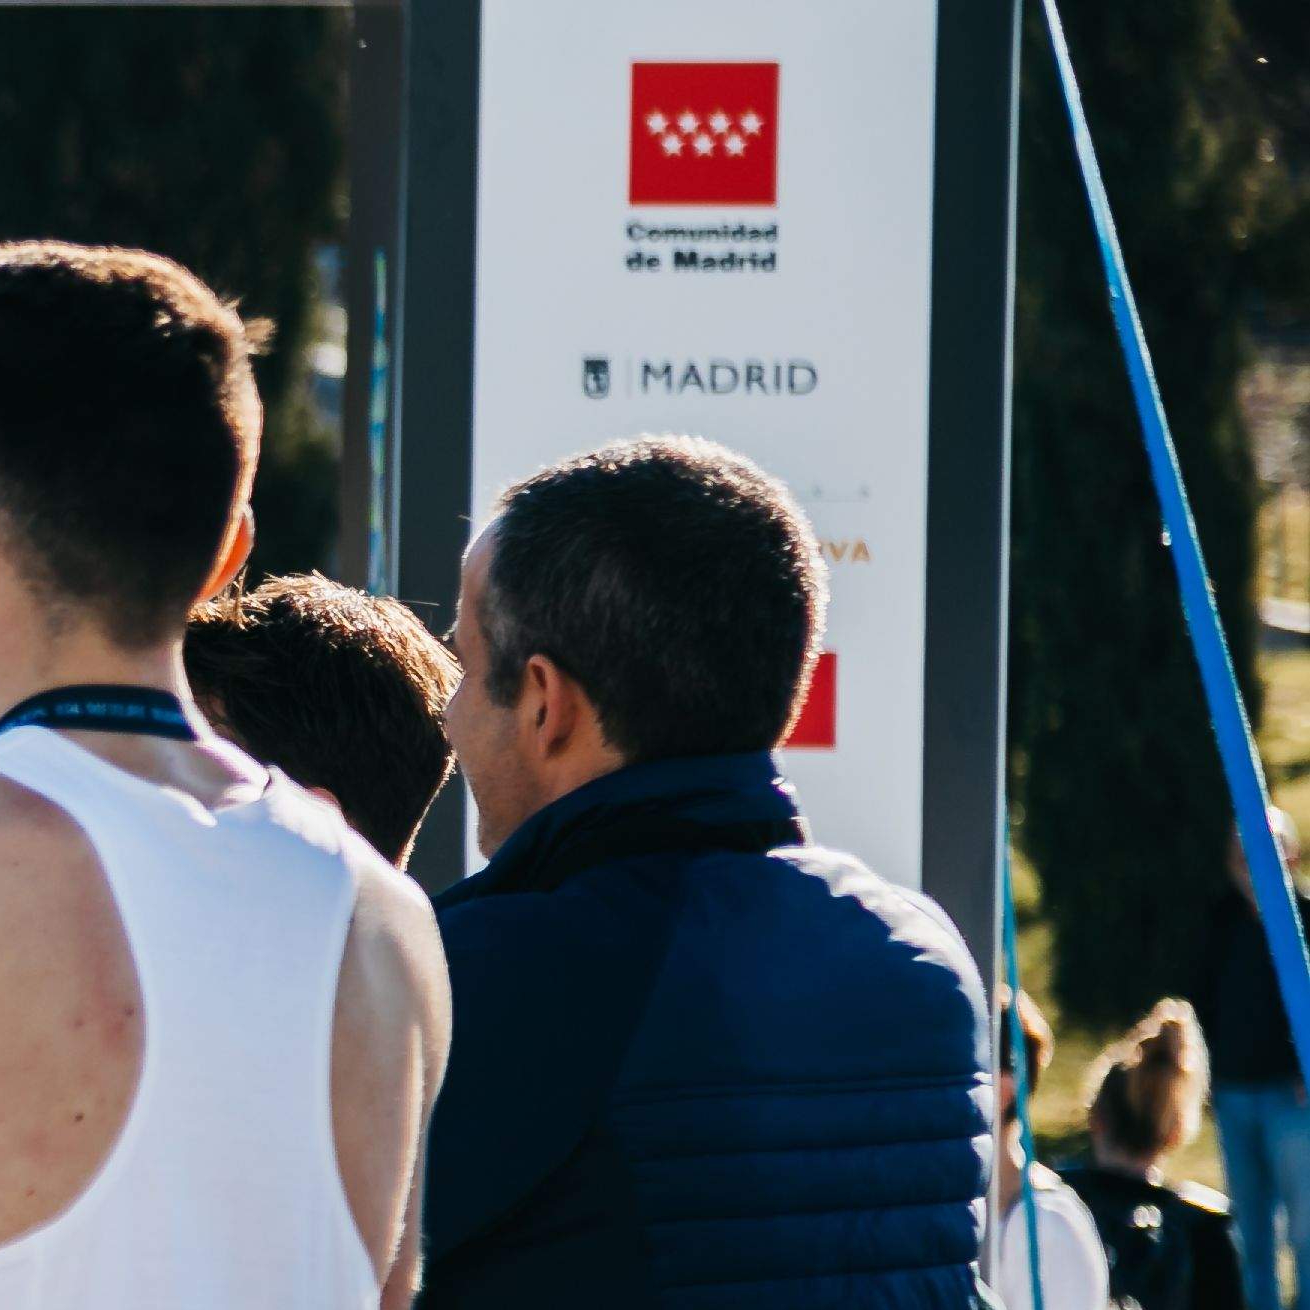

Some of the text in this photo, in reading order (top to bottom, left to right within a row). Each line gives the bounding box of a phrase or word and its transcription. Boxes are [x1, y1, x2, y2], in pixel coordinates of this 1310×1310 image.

[626, 222, 777, 242] Comunidad
[626, 251, 776, 272] de Madrid
[641, 362, 818, 395] MADRID
